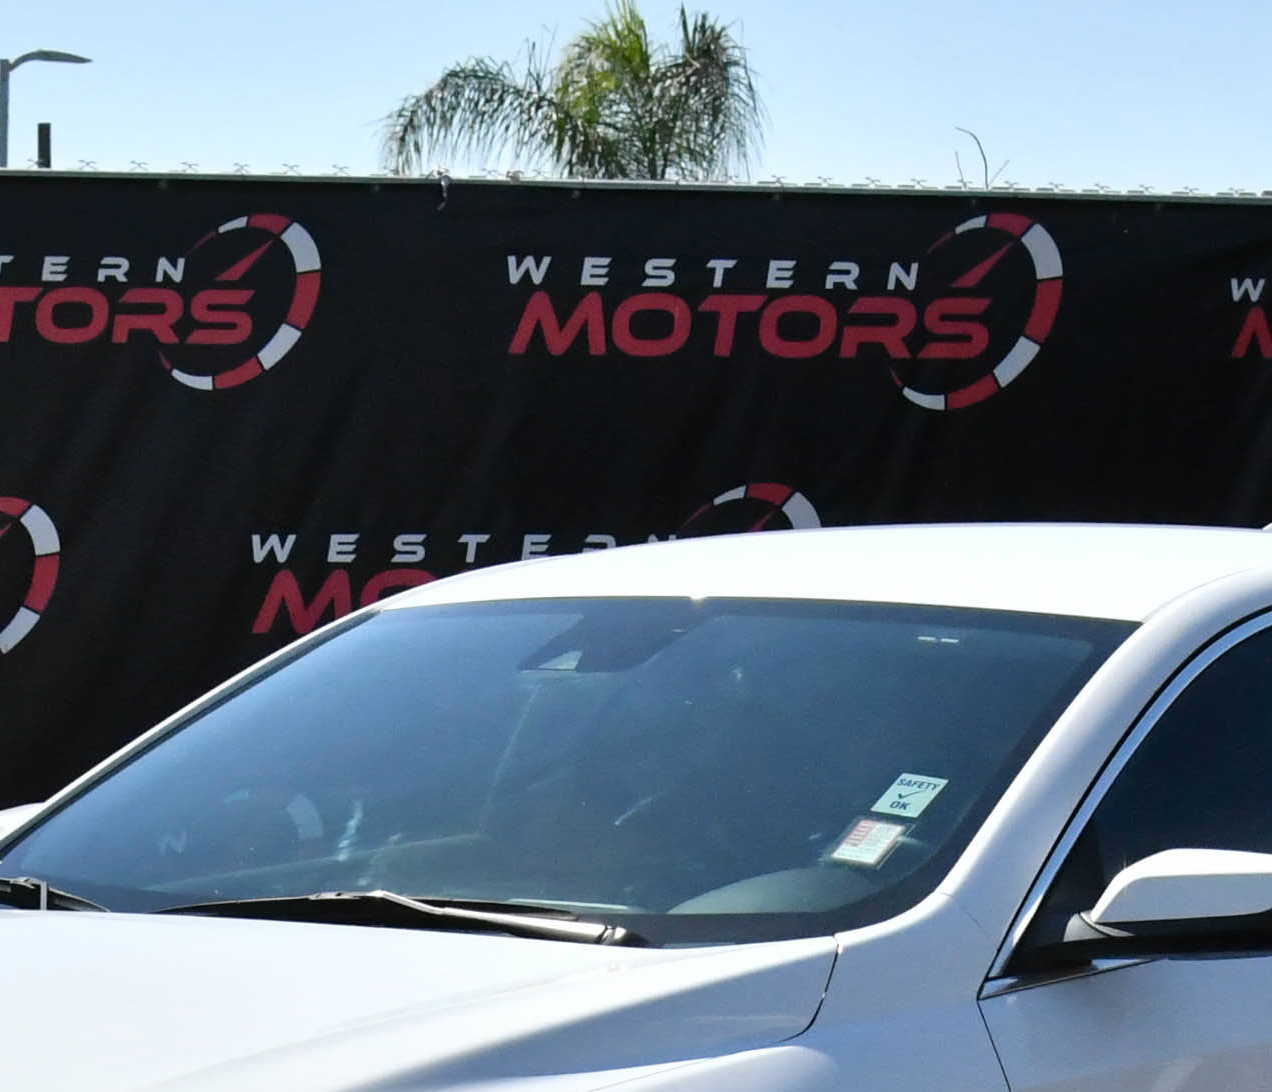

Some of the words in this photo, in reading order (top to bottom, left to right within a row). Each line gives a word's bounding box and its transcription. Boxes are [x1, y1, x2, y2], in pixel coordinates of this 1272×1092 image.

[507, 255, 919, 291] WESTERN
[509, 291, 990, 358] MOTORS
[897, 778, 941, 791] SAFETY
[889, 800, 911, 811] OK
